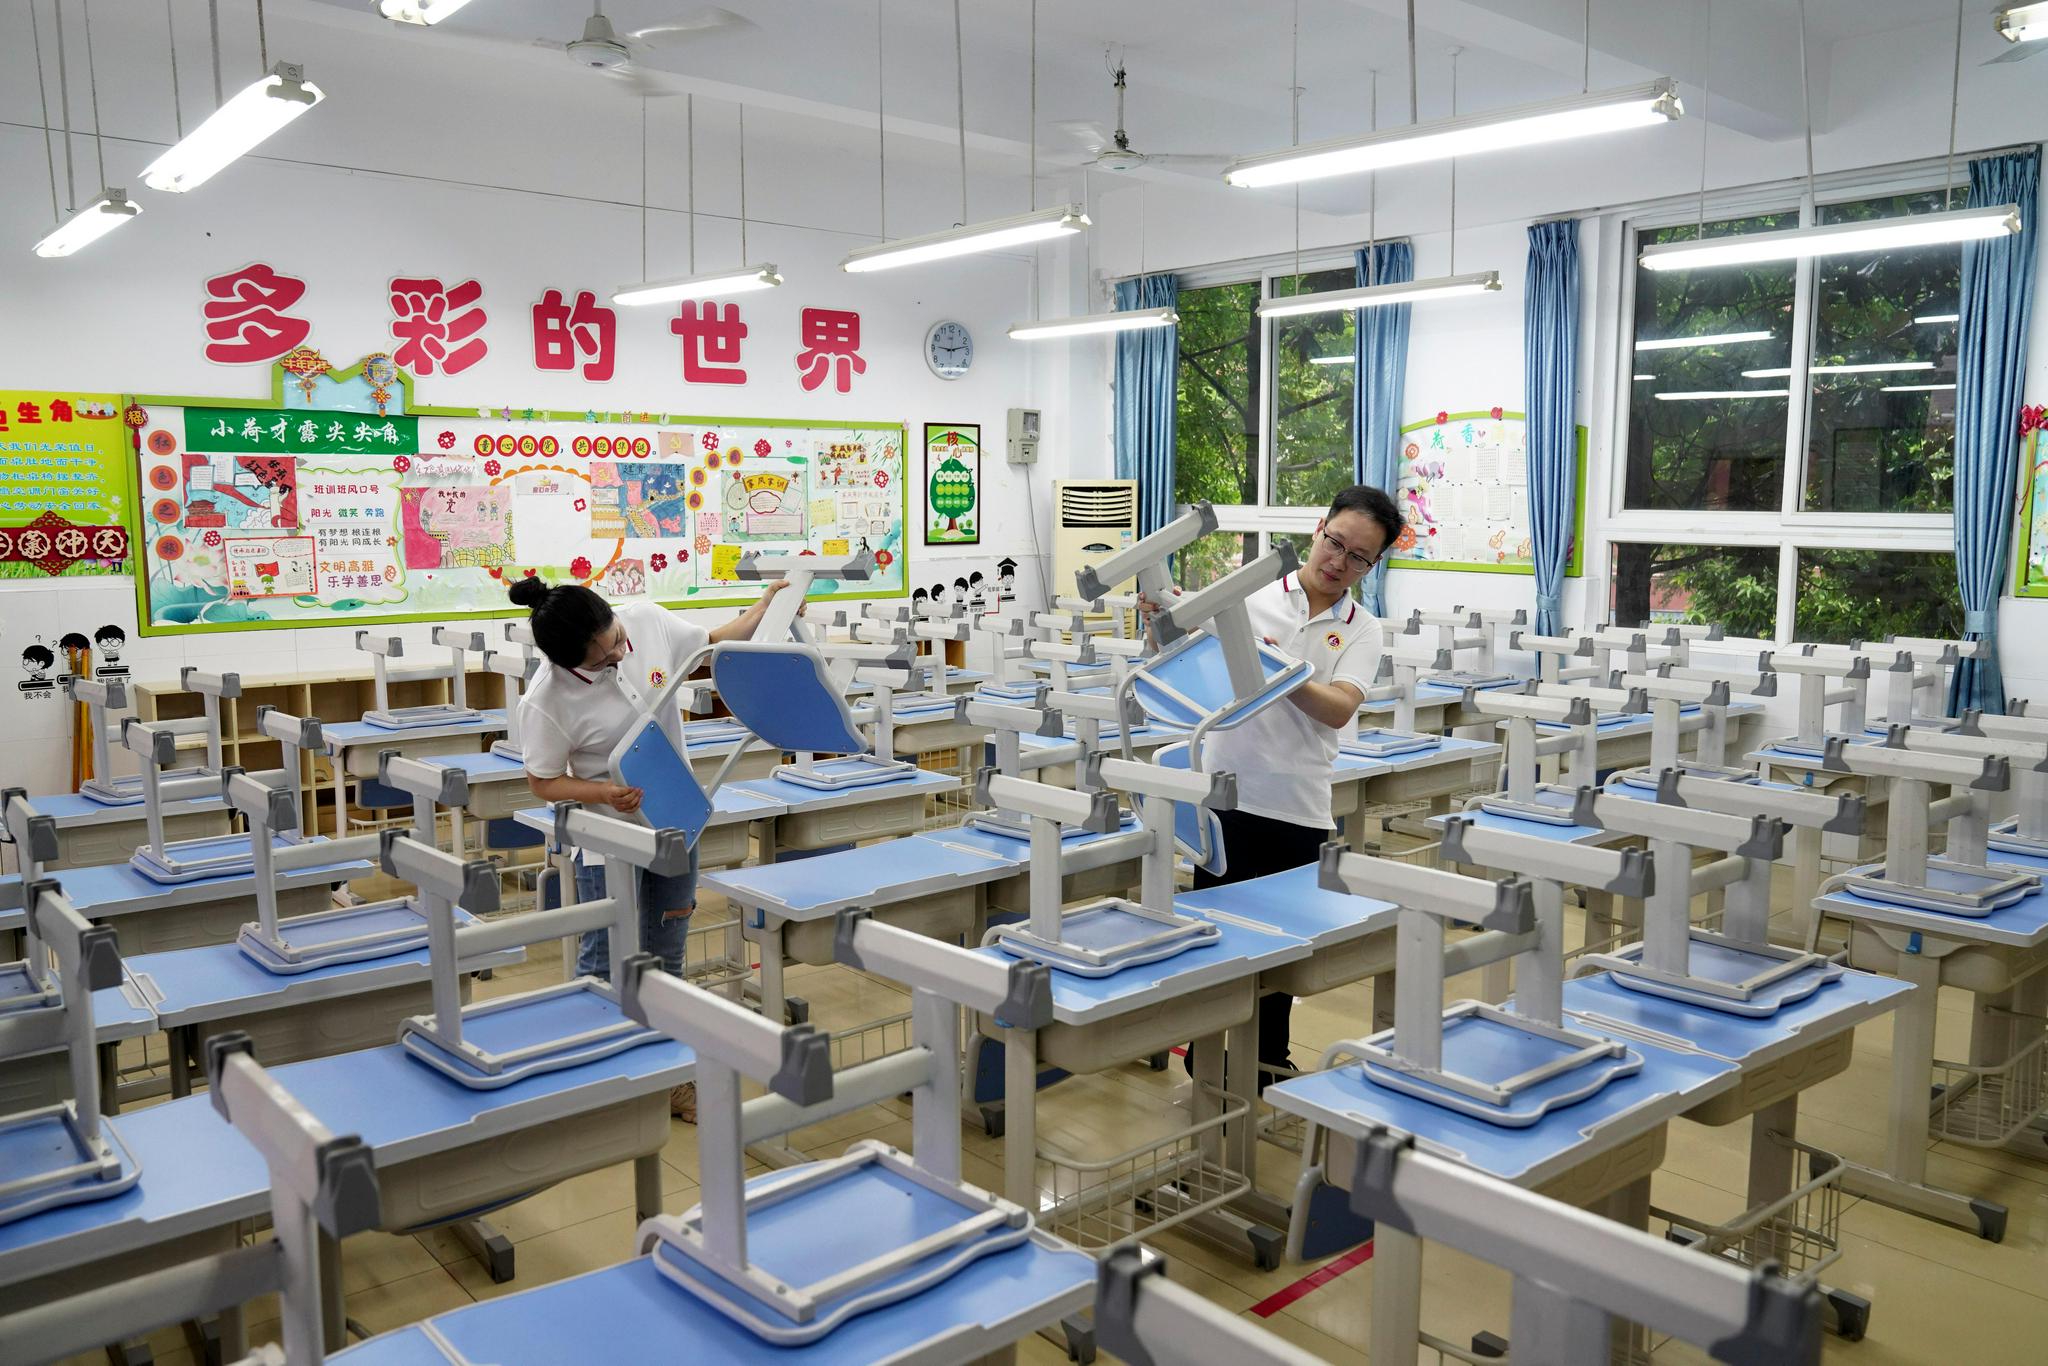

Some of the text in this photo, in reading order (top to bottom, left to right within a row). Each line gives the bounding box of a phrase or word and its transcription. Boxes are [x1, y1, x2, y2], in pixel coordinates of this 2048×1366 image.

[202, 262, 867, 396] 多彩的世界
[962, 336, 968, 345] 2
[127, 410, 145, 425] 福
[211, 416, 400, 445] 小荷才露尖尖角
[314, 484, 379, 494] 班训班风口号
[311, 507, 385, 518] 阳光 微笑 奔跑
[319, 527, 381, 537] 有梦想 根连根
[319, 537, 382, 547] 有阳光 同成长
[320, 560, 375, 573] 文明高雅
[328, 574, 383, 588] 乐学善思
[24, 690, 52, 700] 我不会
